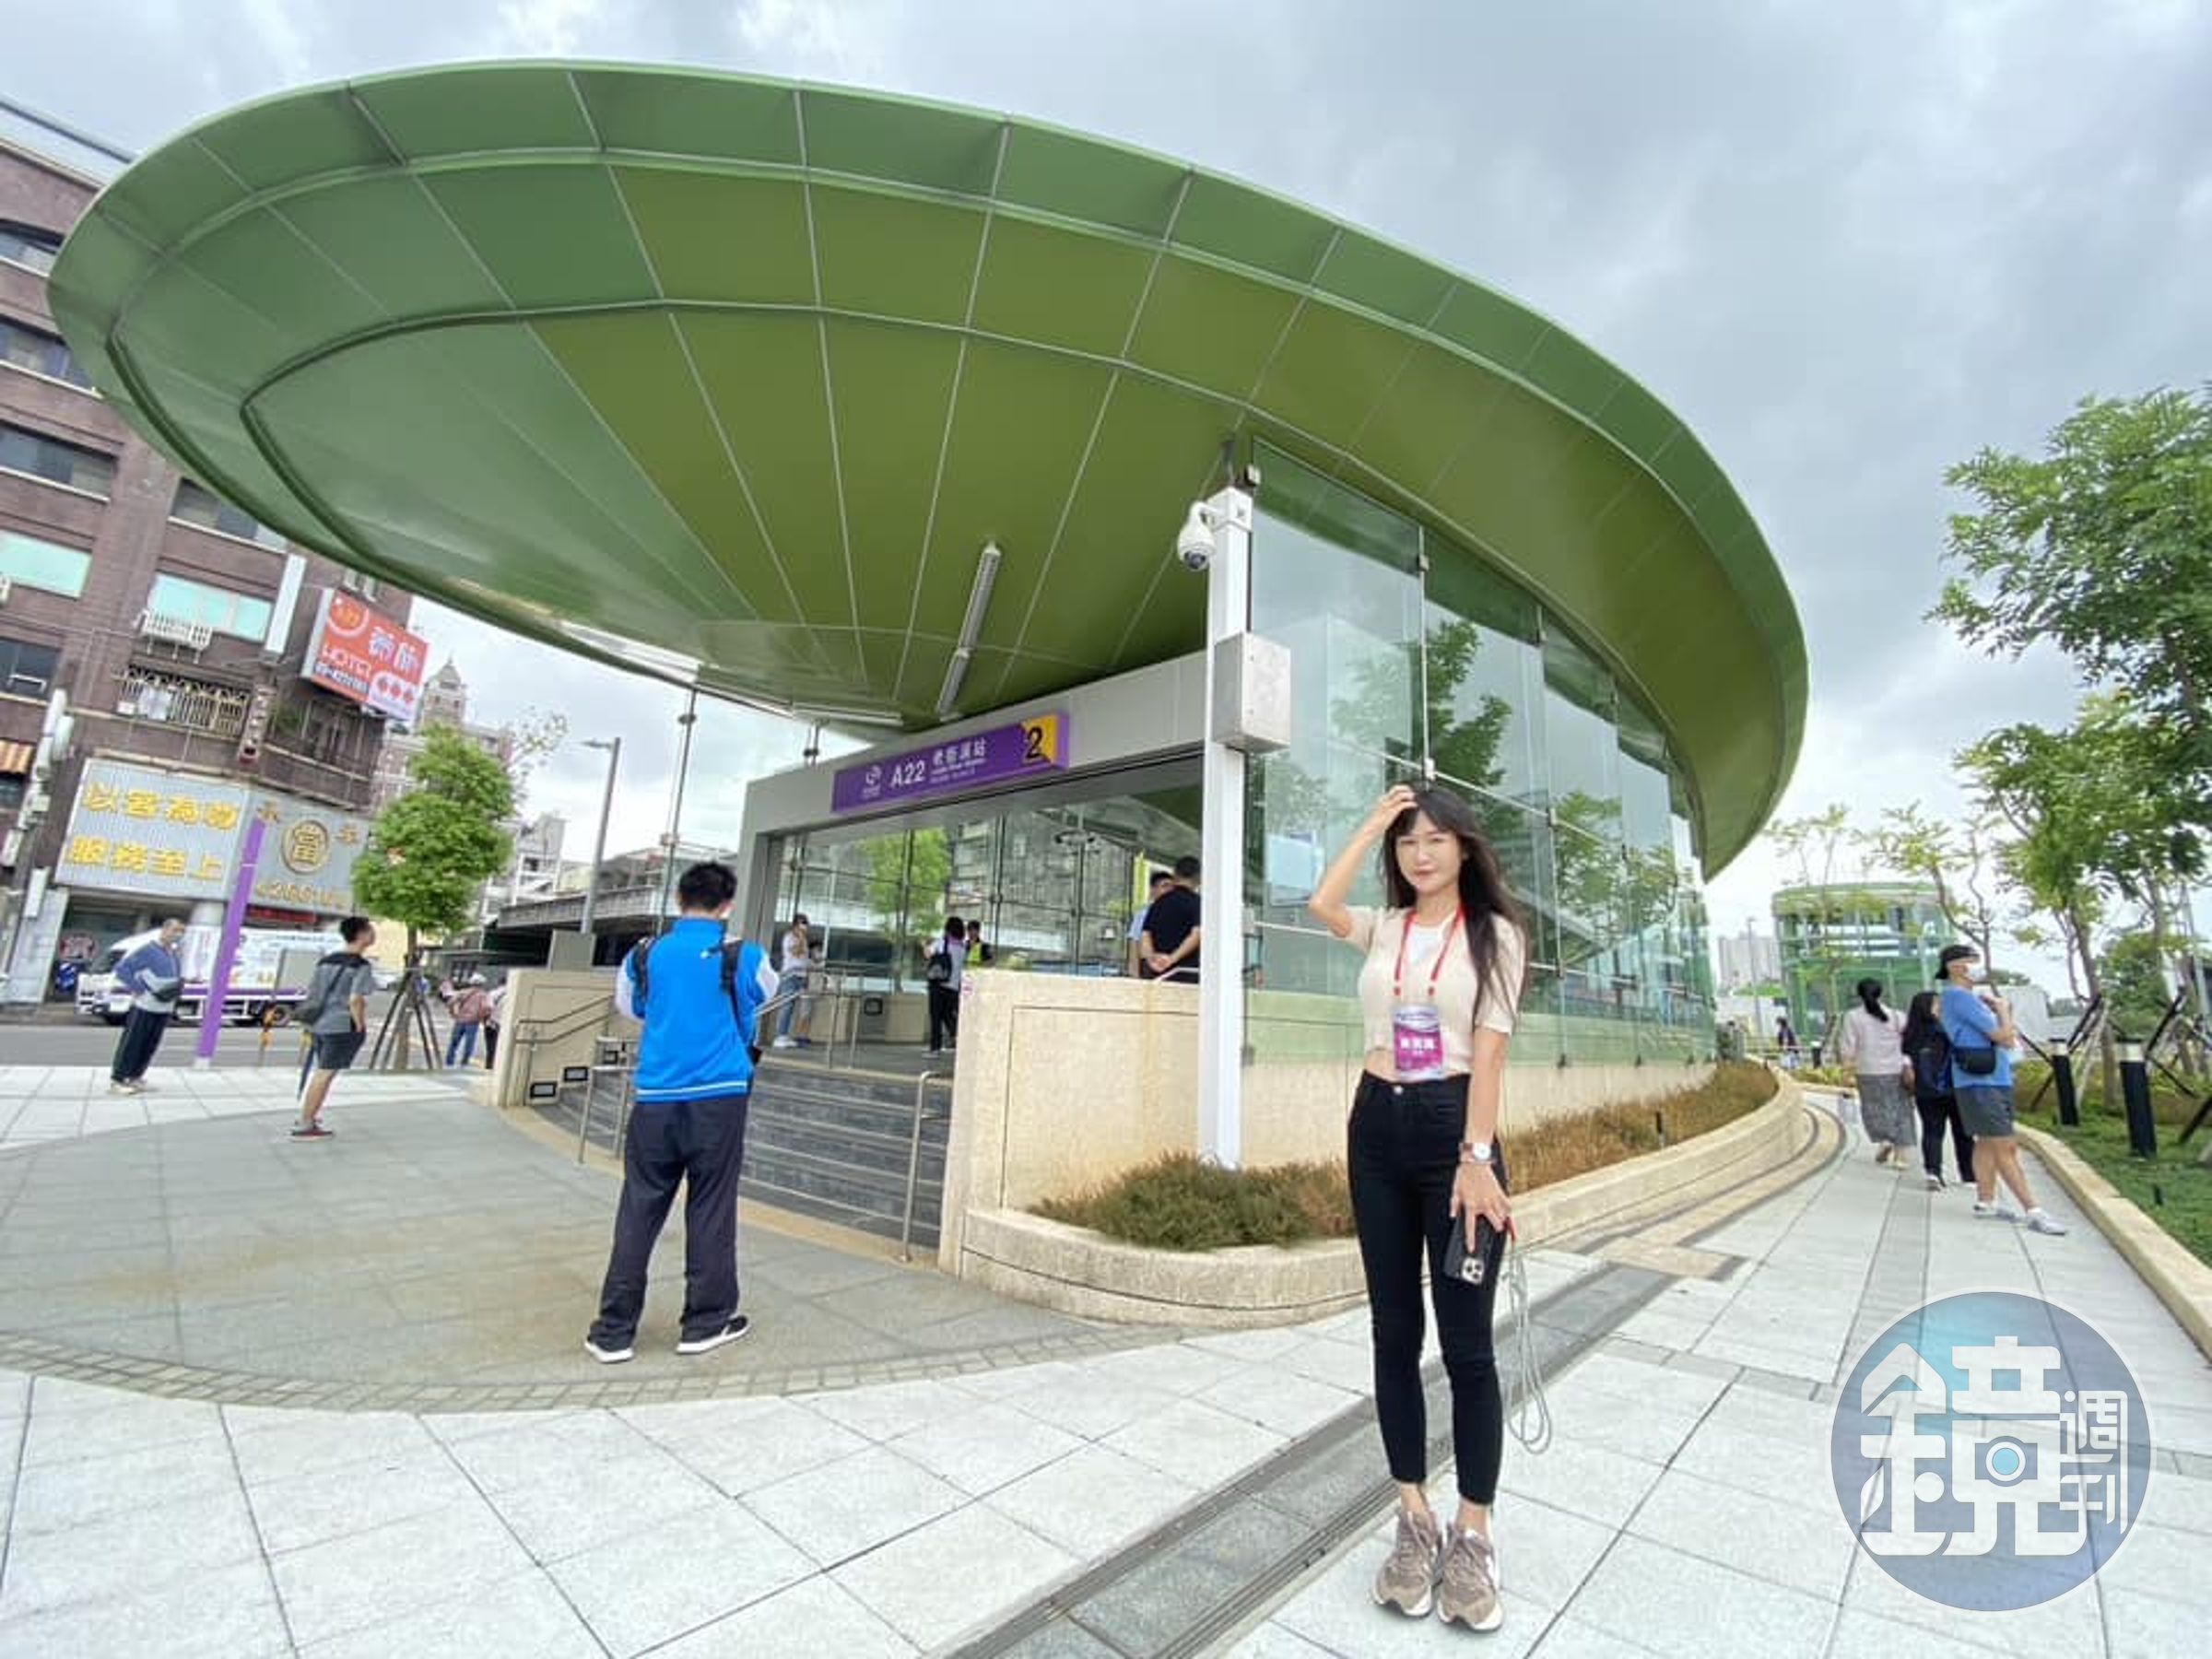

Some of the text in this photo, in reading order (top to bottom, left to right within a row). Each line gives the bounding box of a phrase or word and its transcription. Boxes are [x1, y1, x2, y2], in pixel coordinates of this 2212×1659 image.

[1027, 726, 1043, 759] 2
[890, 760, 925, 788] A22
[70, 835, 223, 880] 服務至上
